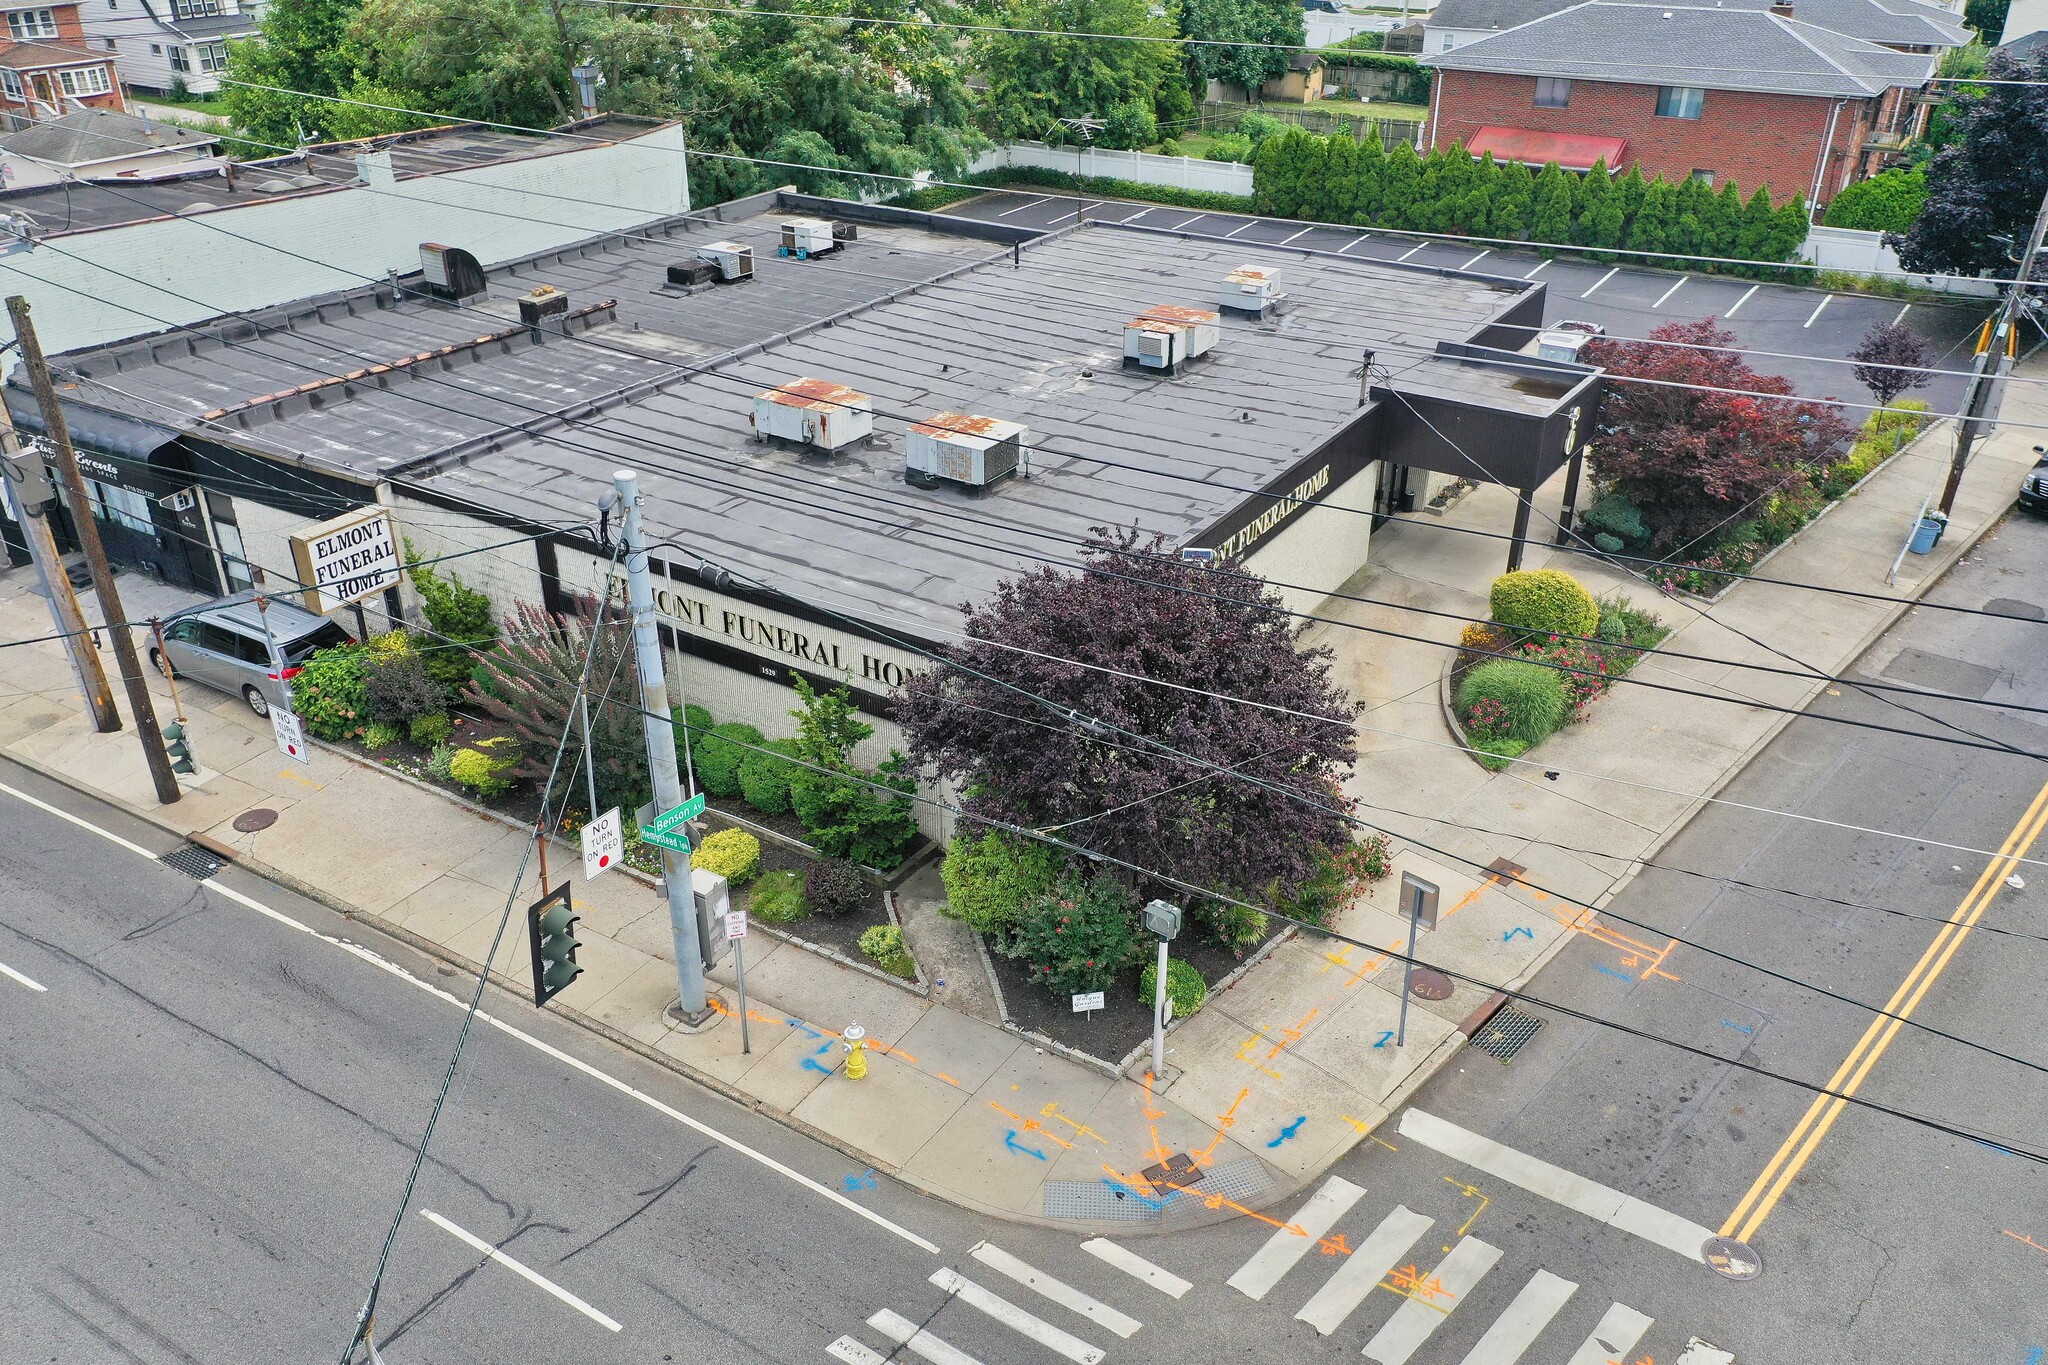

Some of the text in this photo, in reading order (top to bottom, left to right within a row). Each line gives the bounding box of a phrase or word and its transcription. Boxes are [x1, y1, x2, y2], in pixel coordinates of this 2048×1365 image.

[97, 469, 118, 480] SPACE
[1237, 492, 1295, 553] FUNERAL
[1292, 464, 1330, 509] HOME
[316, 519, 383, 559] ELMONT
[316, 541, 394, 584] FUNERAL
[336, 568, 384, 600] HOME
[723, 610, 849, 671] FUNERAL
[761, 666, 776, 676] 1529
[277, 711, 290, 724] NO
[278, 721, 296, 736] TURN
[276, 730, 302, 748] ON RED
[656, 803, 702, 831] Benson Av
[592, 819, 608, 836] NO
[591, 829, 613, 847] TURN
[641, 828, 678, 847] Hempstead
[587, 837, 619, 862] ON RED
